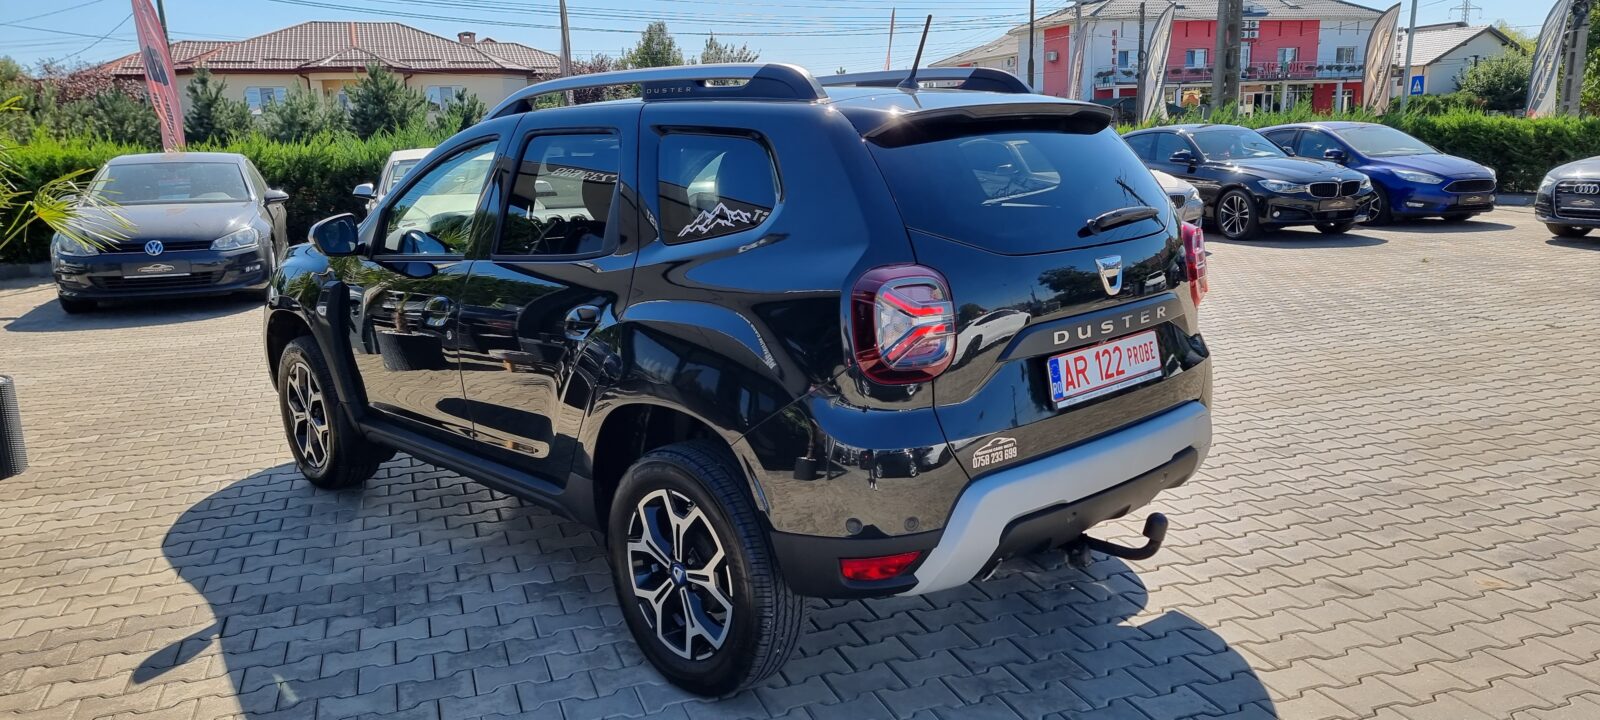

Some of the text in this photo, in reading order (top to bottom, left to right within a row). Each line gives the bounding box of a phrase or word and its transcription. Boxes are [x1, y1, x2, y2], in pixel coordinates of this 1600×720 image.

[646, 86, 692, 94] DUSTER
[1053, 306, 1167, 345] DUSTER
[1065, 355, 1091, 392] AR
[1094, 346, 1126, 381] 122
[1126, 341, 1156, 367] PROBE
[1052, 381, 1063, 395] RO
[972, 446, 1017, 469] 0758 233 699
